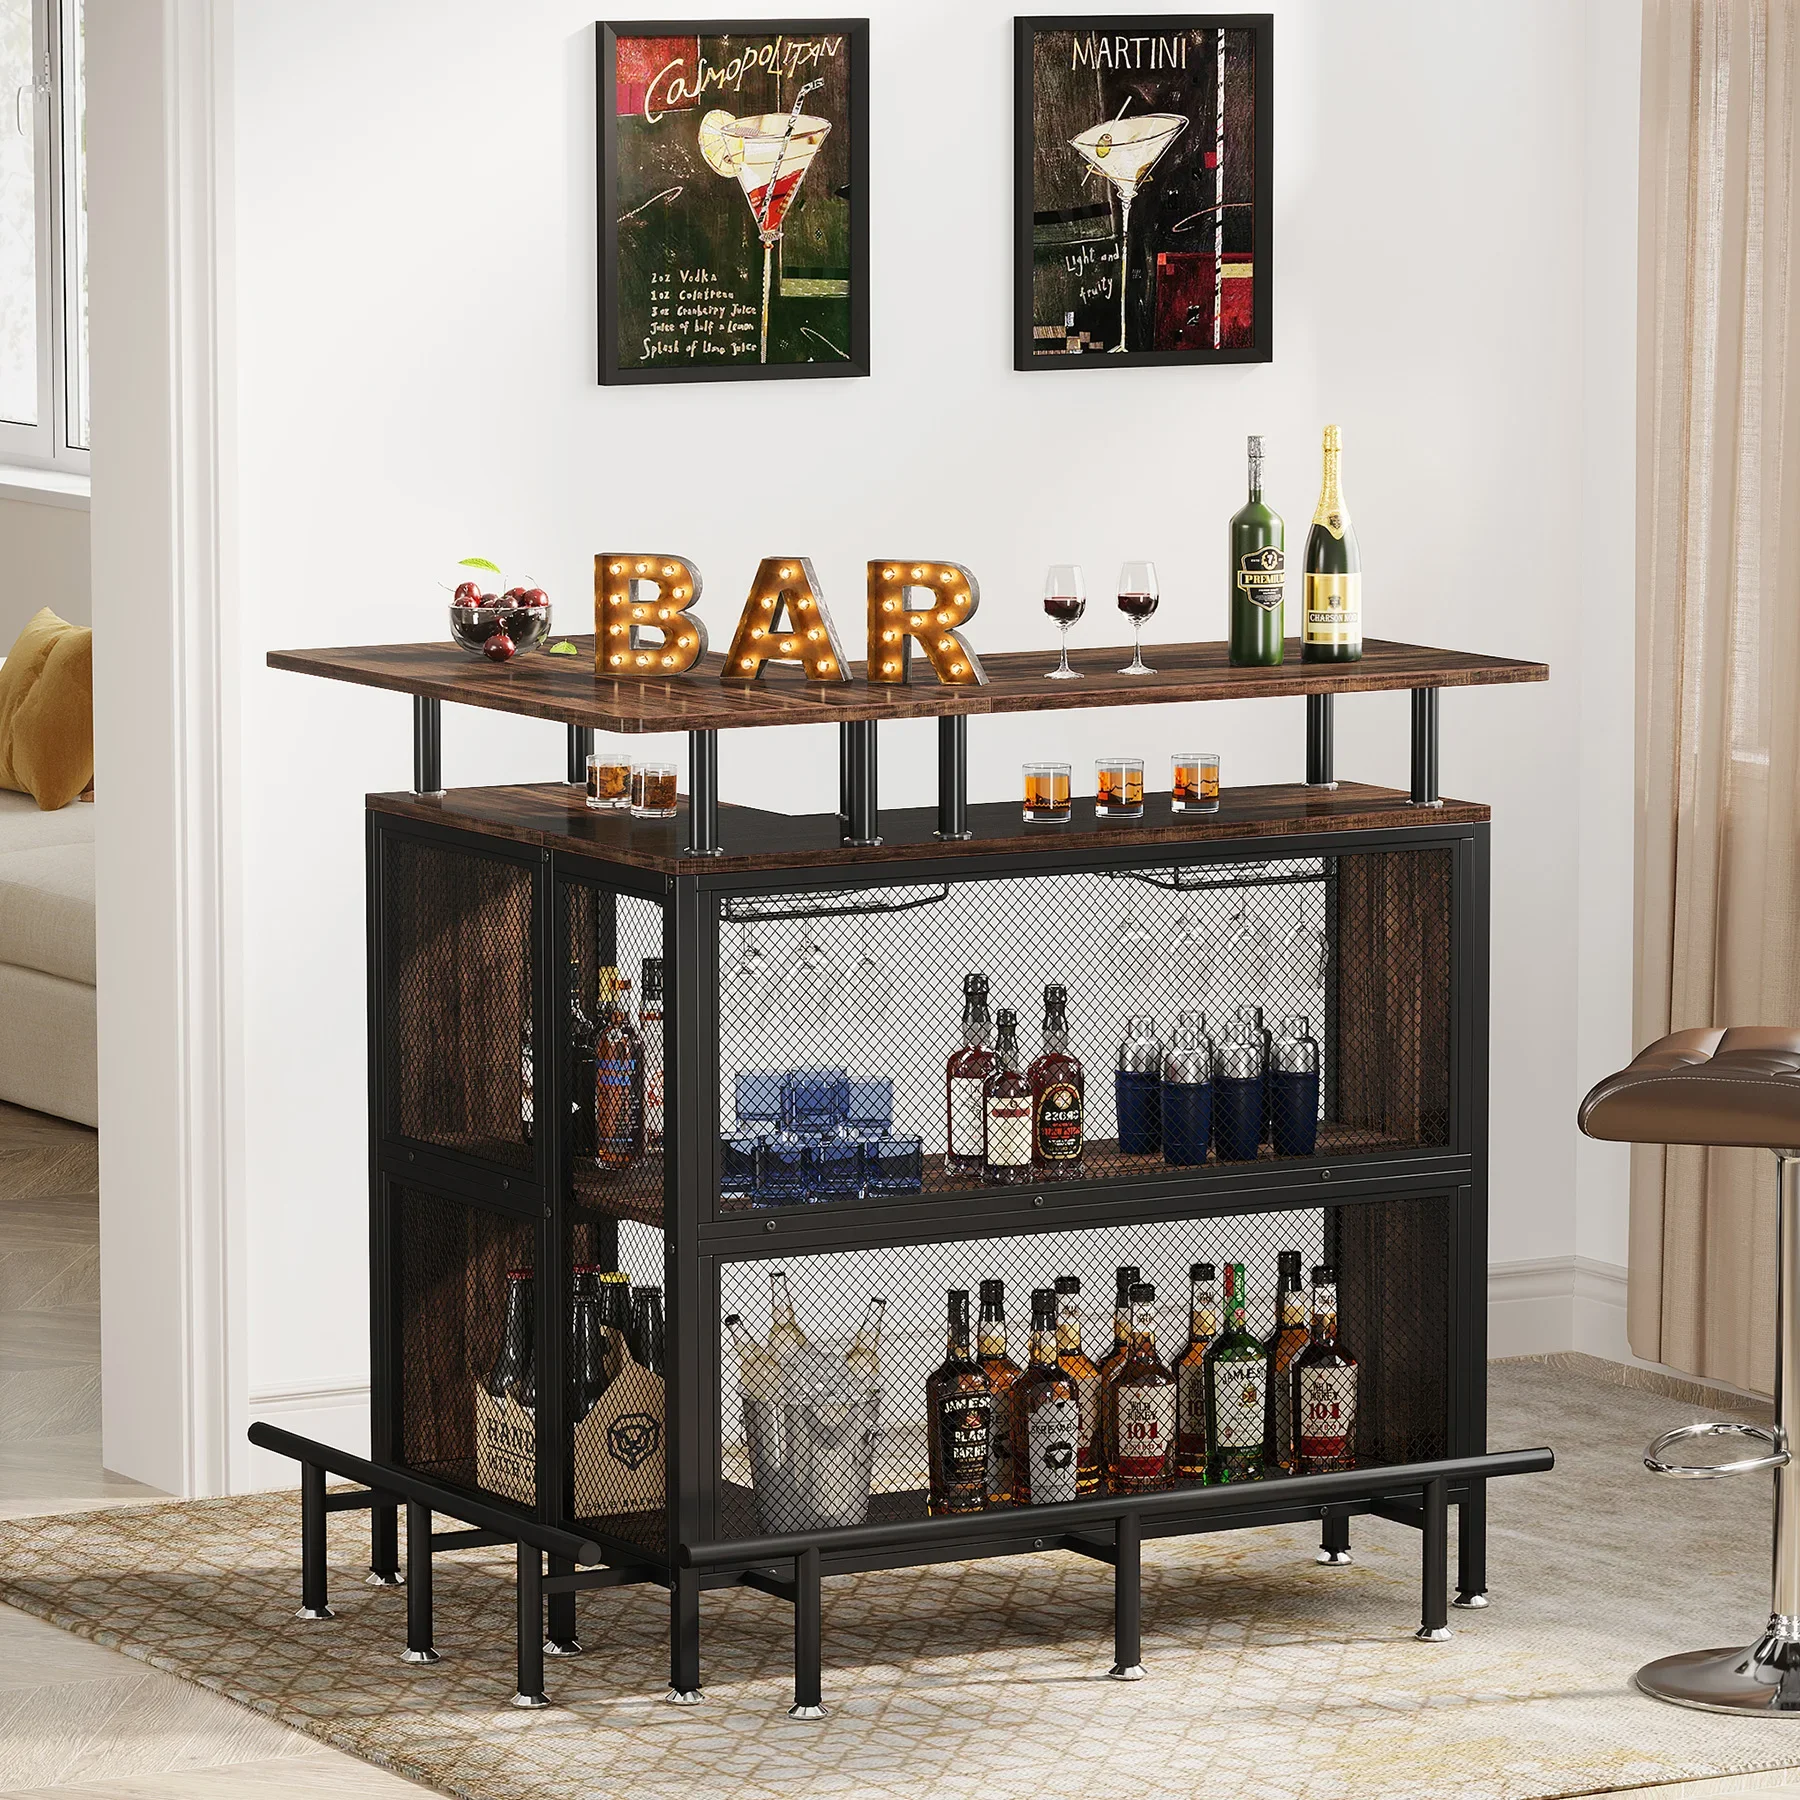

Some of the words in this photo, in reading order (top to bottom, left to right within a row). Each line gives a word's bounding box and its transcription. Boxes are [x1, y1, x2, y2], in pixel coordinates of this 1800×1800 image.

[1071, 36, 1186, 71] MARTINI
[1065, 245, 1095, 277] Light
[1100, 242, 1120, 262] and
[680, 268, 718, 284] Vodka
[1079, 276, 1113, 305] fruity
[677, 304, 726, 319] Cranberry
[679, 320, 690, 335] of
[640, 337, 680, 360] Splash
[685, 340, 699, 358] of
[594, 552, 990, 686] BAR
[1127, 1422, 1160, 1440] 101
